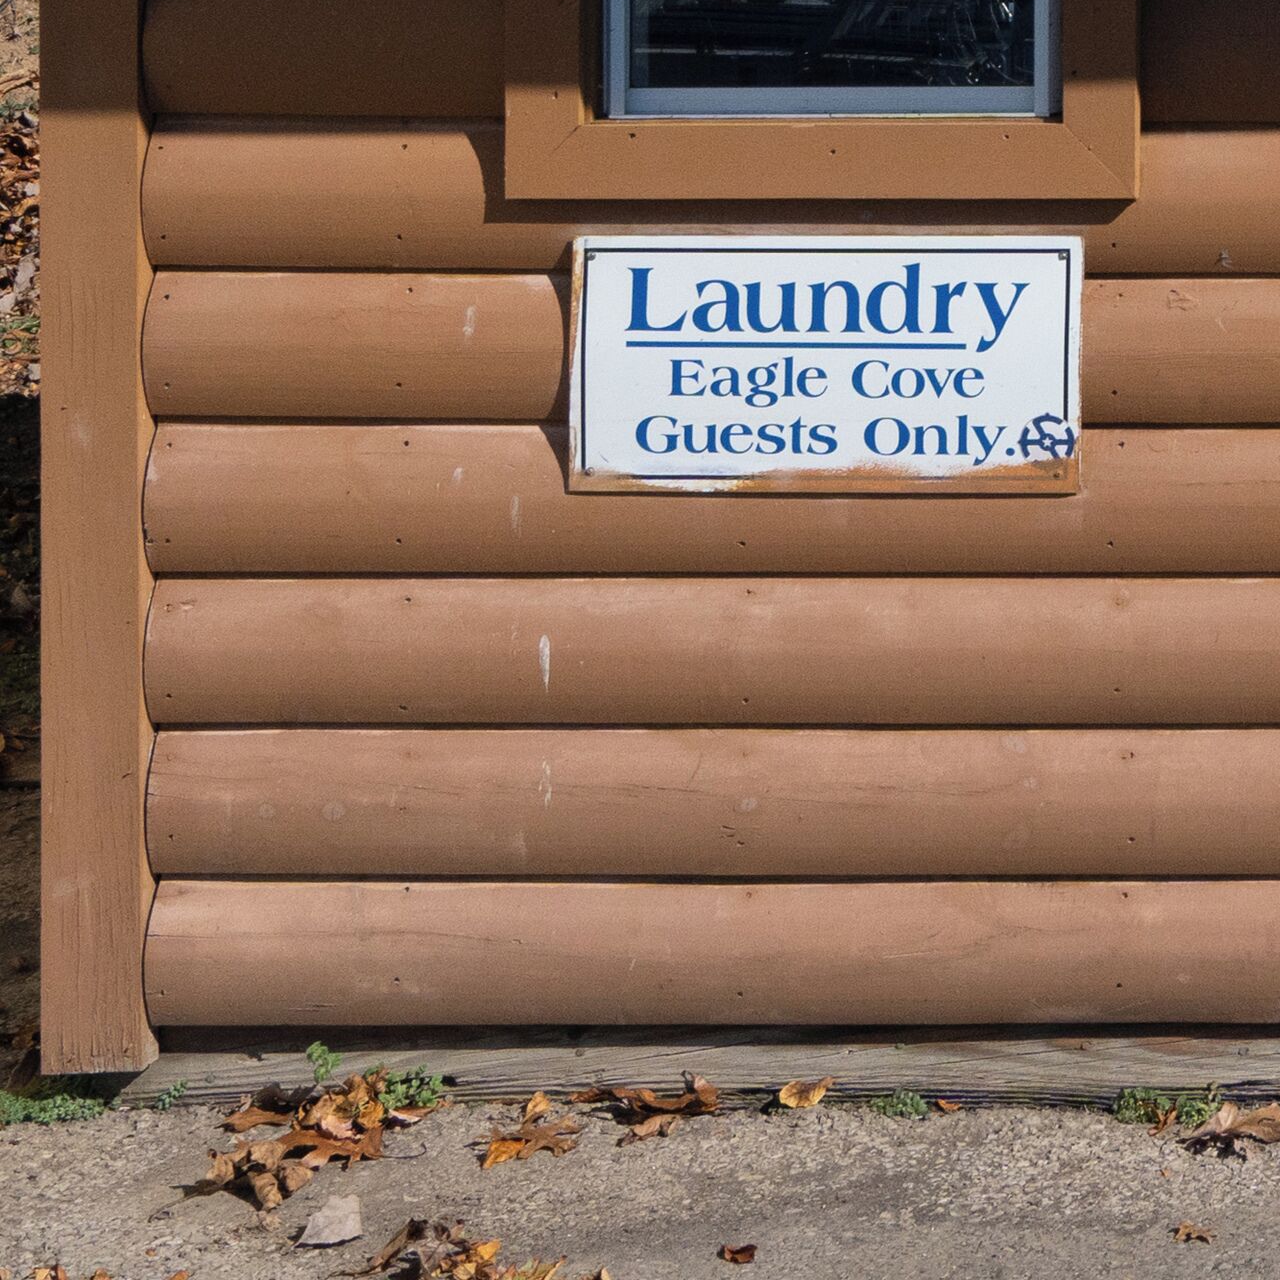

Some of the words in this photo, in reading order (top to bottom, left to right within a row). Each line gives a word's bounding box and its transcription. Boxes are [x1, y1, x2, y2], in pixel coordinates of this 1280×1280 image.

[625, 262, 1030, 353] Laundry
[669, 356, 828, 407] Eagle
[852, 359, 985, 399] Cove
[635, 415, 838, 455] Guests
[863, 416, 1016, 466] Only.
